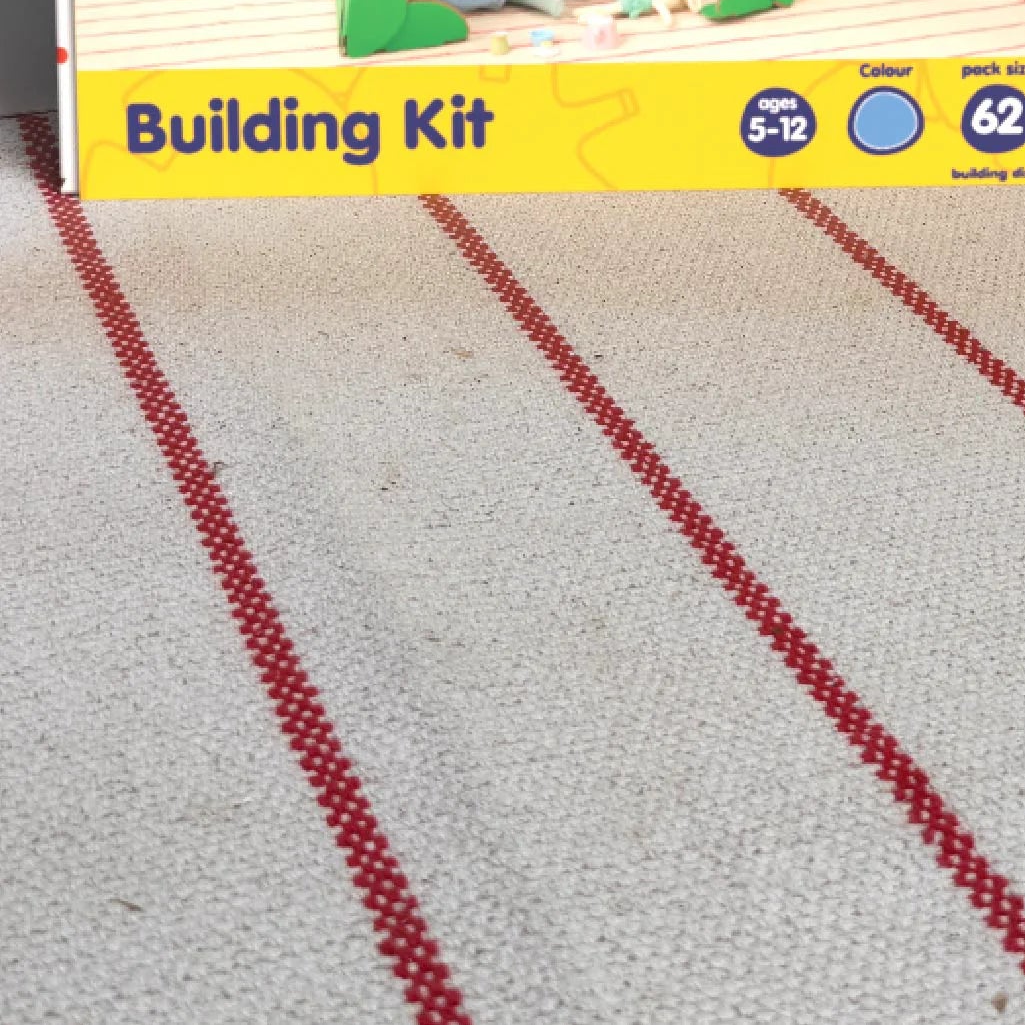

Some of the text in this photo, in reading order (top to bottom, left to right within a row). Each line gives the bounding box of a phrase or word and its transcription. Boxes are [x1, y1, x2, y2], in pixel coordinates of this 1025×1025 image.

[859, 63, 913, 78] Colour
[961, 62, 1000, 79] pack
[758, 98, 798, 113] ages
[971, 96, 1024, 136] 62
[126, 94, 494, 165] Building Kit
[748, 116, 808, 142] 5-12
[951, 167, 1008, 181] building
